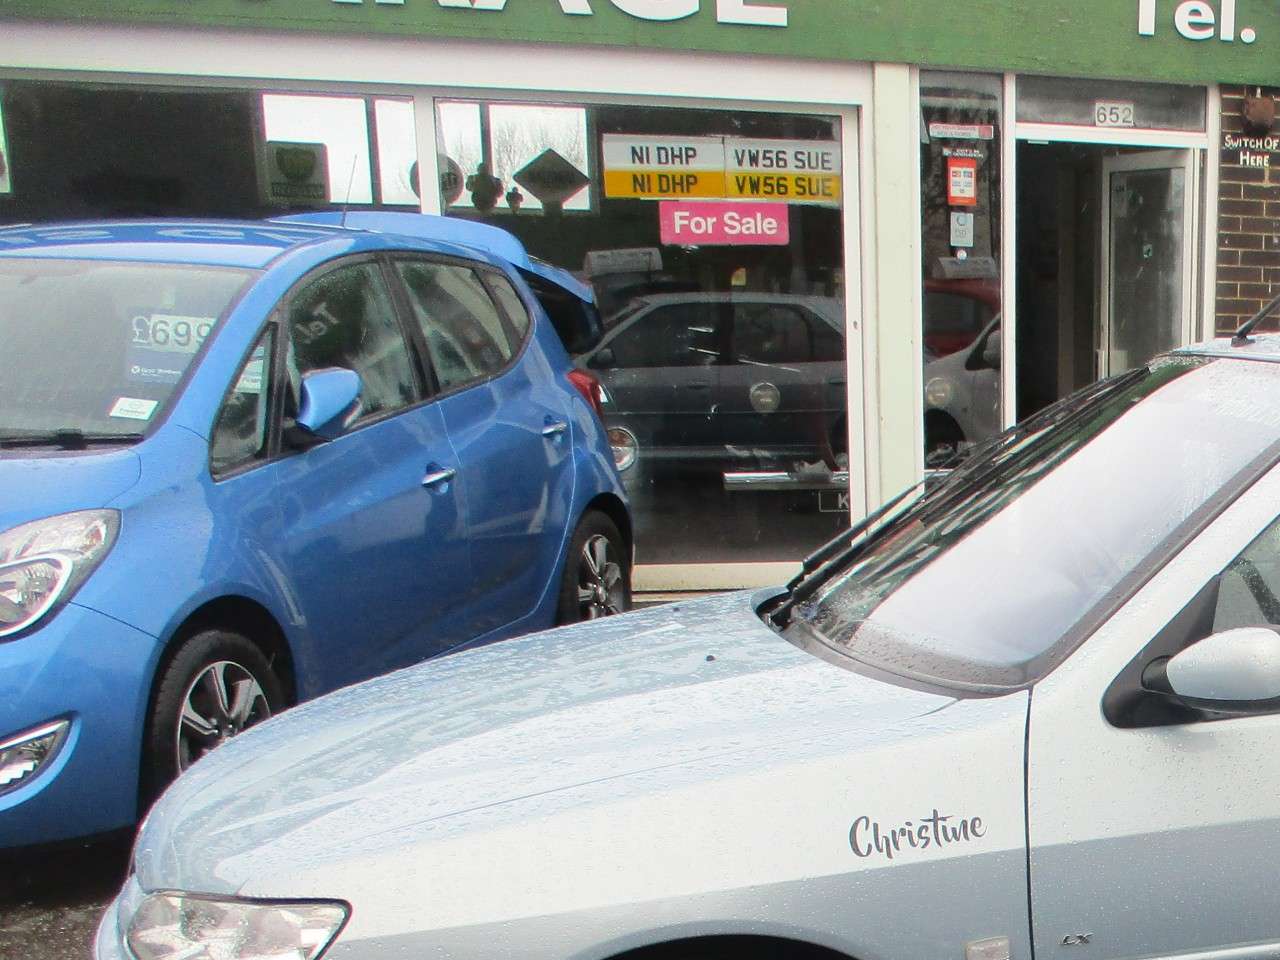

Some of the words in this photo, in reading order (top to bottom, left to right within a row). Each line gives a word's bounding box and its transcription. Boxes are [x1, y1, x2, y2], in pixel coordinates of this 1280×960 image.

[1096, 106, 1133, 123] 652
[656, 146, 697, 165] DHP
[734, 149, 788, 169] VW56
[793, 150, 833, 171] SUE
[657, 174, 698, 193] DHP
[735, 176, 788, 195] VW56
[794, 177, 833, 197] SUE
[673, 211, 716, 234] For
[723, 212, 778, 235] Sale
[849, 809, 988, 859] Christine
